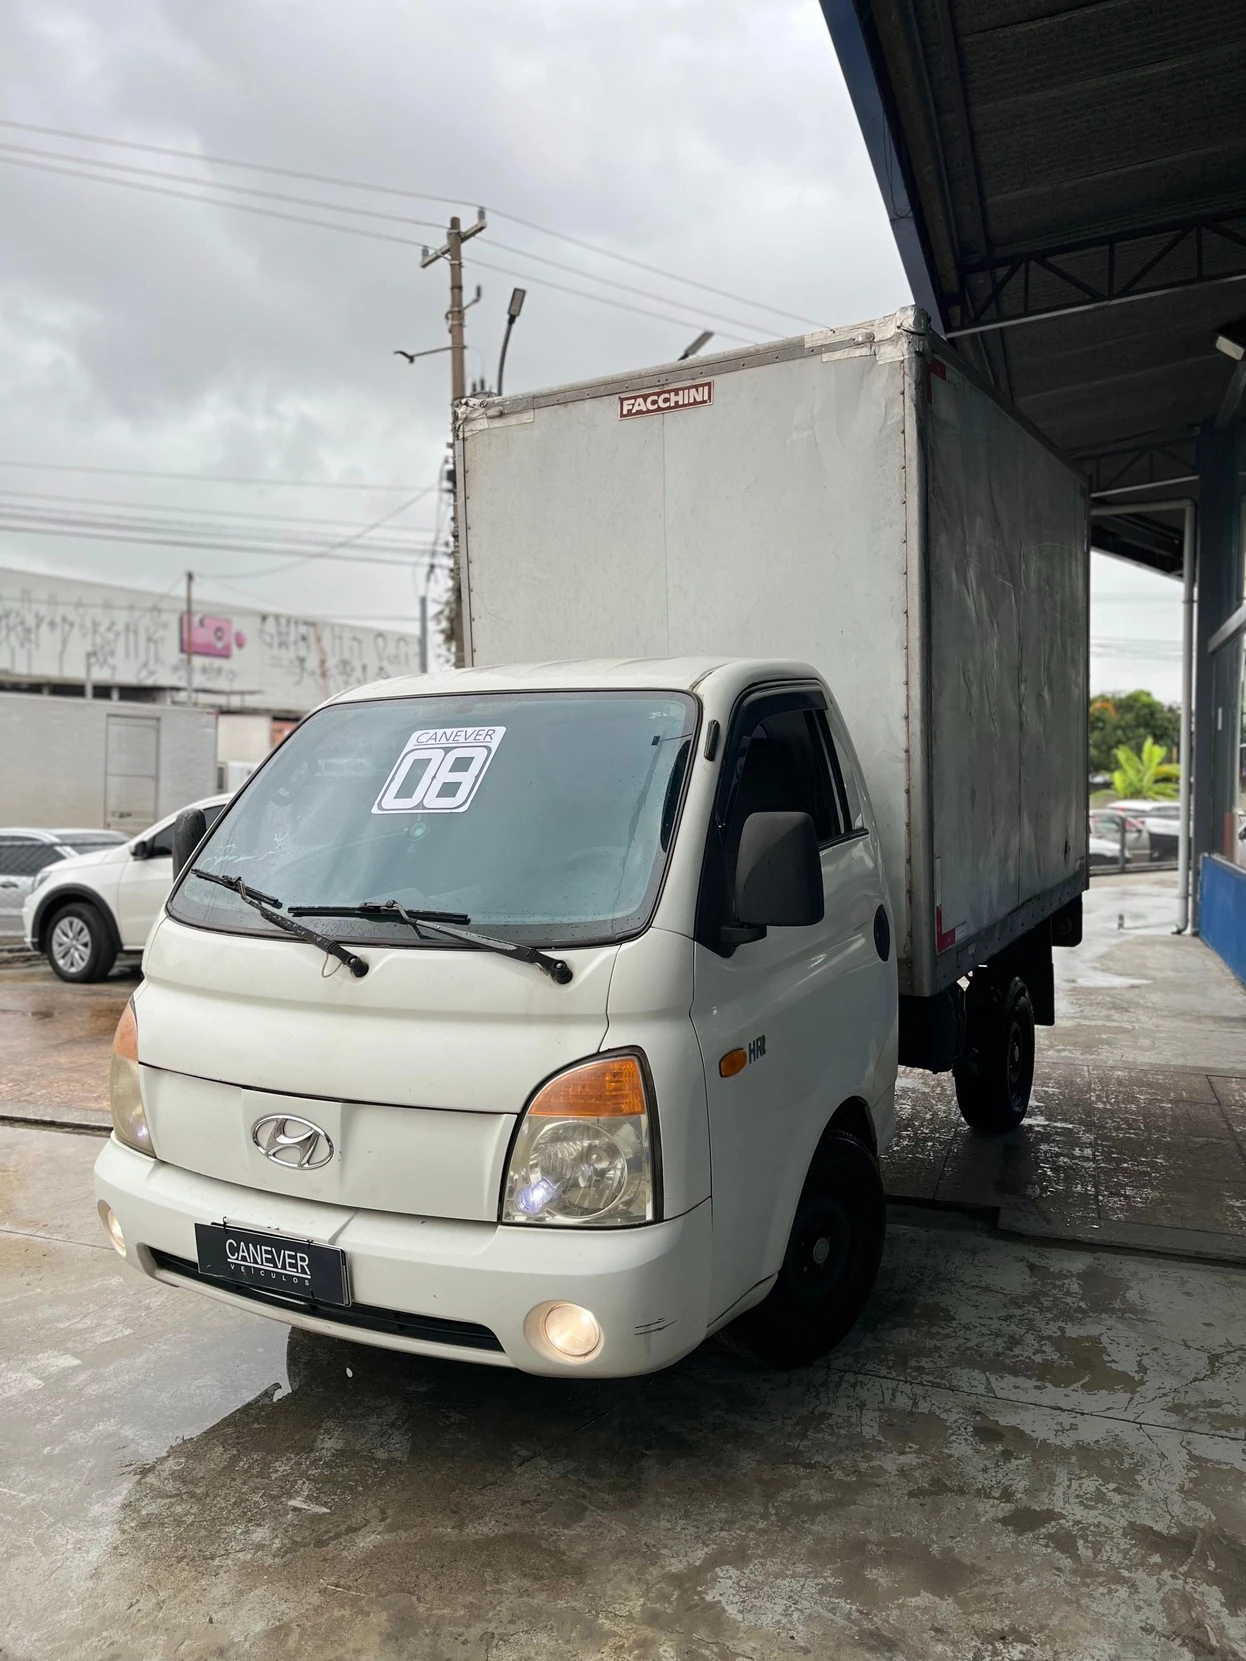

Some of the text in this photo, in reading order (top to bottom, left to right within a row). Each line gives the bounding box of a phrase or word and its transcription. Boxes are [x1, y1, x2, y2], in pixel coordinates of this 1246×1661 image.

[622, 385, 709, 415] FACCHINI
[416, 728, 496, 744] CANEVER
[381, 746, 488, 810] 08
[225, 1238, 311, 1275] CANEVER
